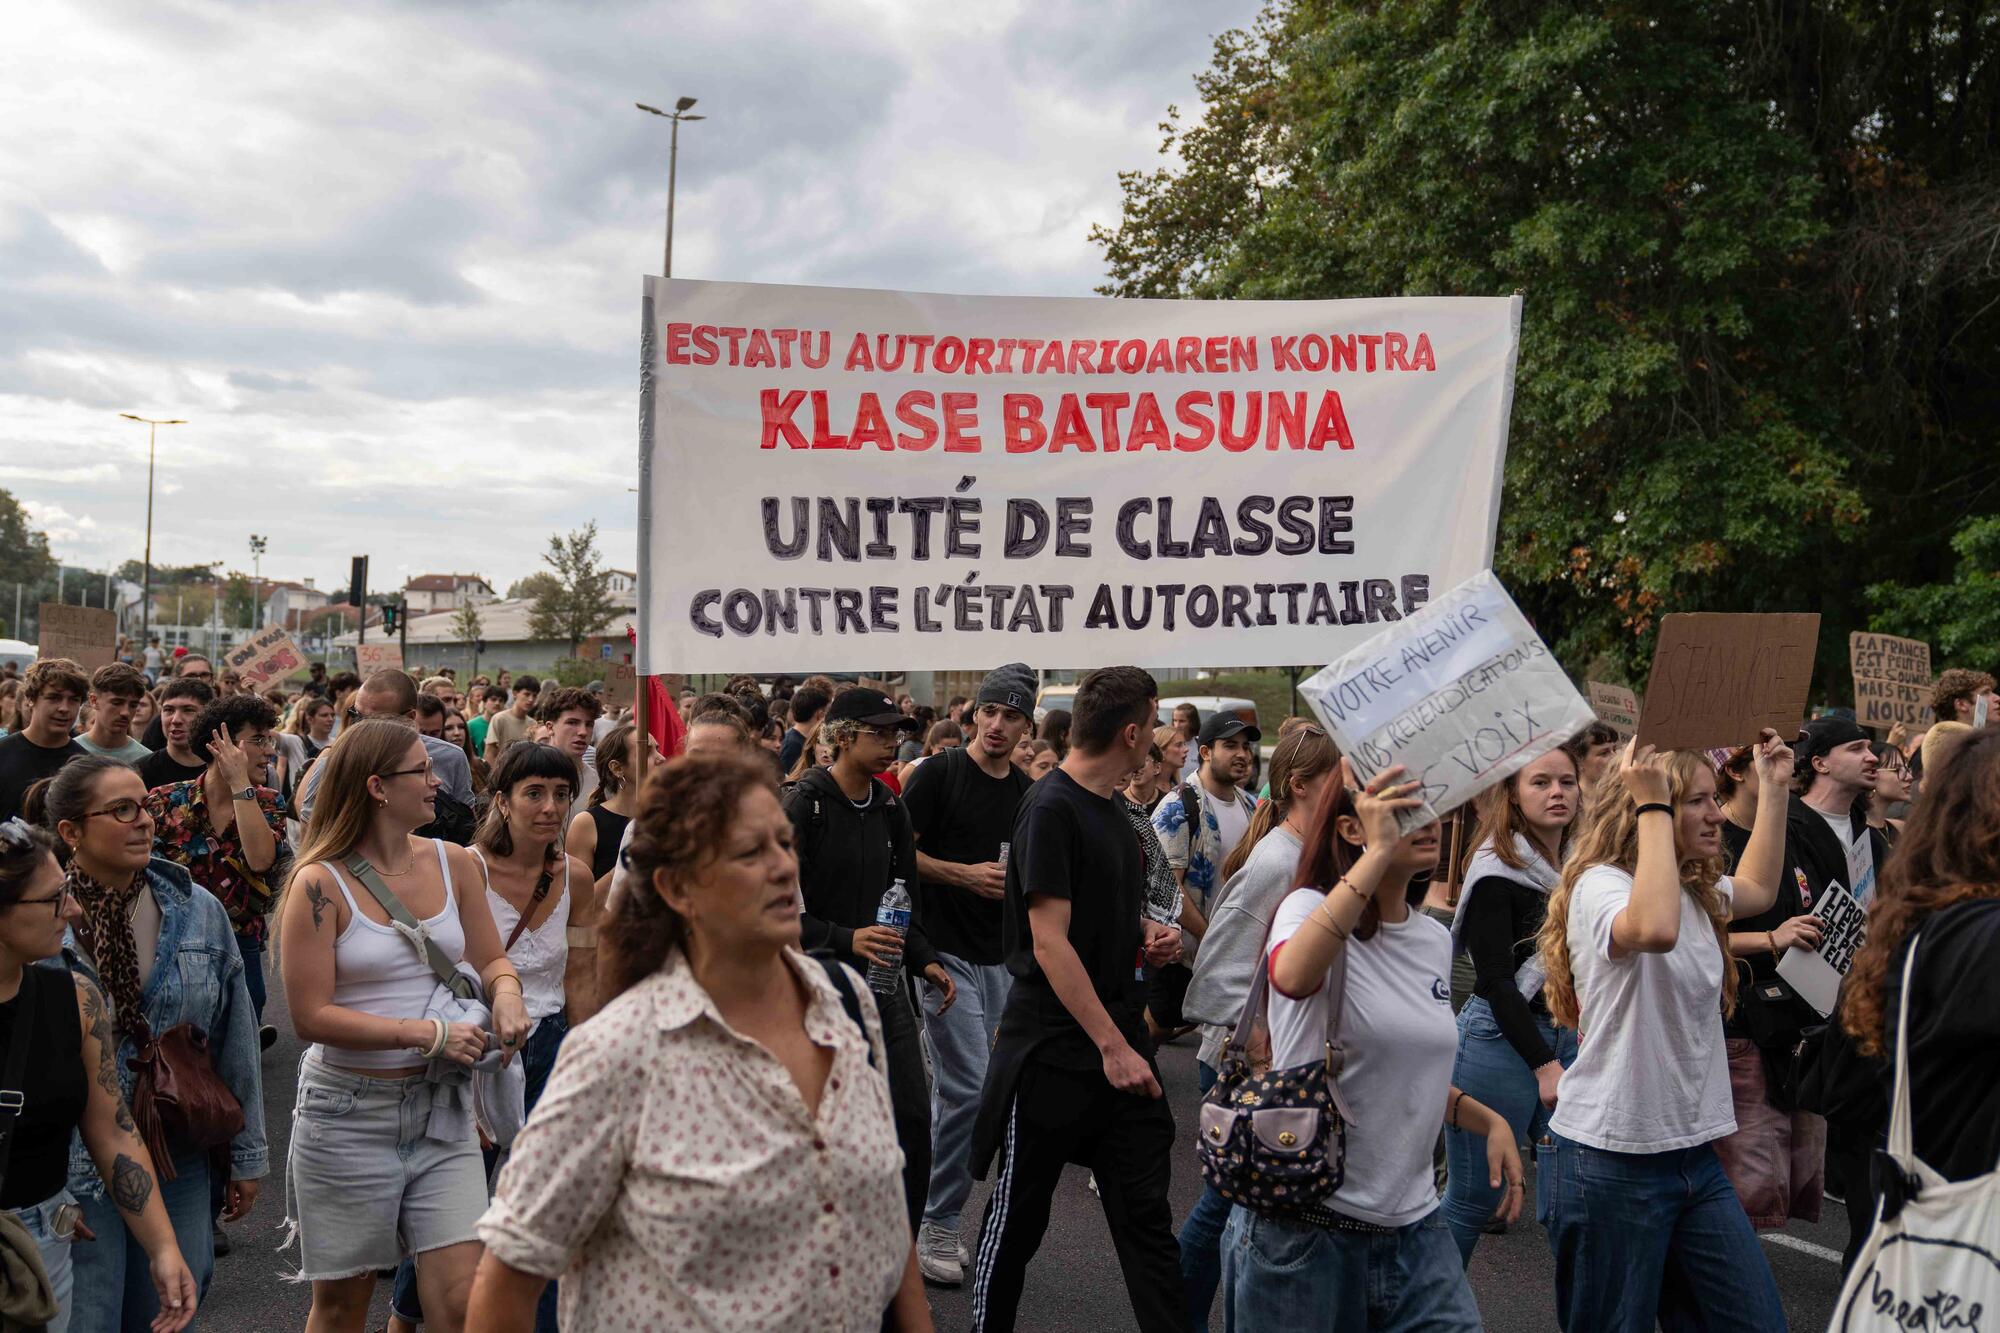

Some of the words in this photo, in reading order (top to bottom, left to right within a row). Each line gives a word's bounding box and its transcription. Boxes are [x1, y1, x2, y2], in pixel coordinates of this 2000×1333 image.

[665, 322, 831, 369] ESTATU
[844, 332, 1258, 375] AUTORITARIOAREN
[1270, 331, 1437, 372] KONTRA
[760, 388, 982, 453] KLASE
[1003, 389, 1355, 454] BATASUNA
[761, 475, 982, 562] UNITÉ
[1004, 496, 1094, 560] DE
[1115, 495, 1355, 561] CLASSE
[689, 585, 900, 639] CONTRE
[914, 570, 1075, 634] L'ÉTAT
[1083, 573, 1430, 631] AUTORITAIRE
[1855, 636, 1877, 650] LA
[1882, 638, 1927, 659] FRANCE
[1856, 651, 1884, 667] EST
[1888, 654, 1913, 671] PEUT
[1318, 655, 1402, 731] NOTRE
[1859, 682, 1894, 698] MAIS
[1898, 685, 1920, 702] PAS
[1349, 740, 1393, 781] NOS
[1823, 945, 1851, 976] ELE
